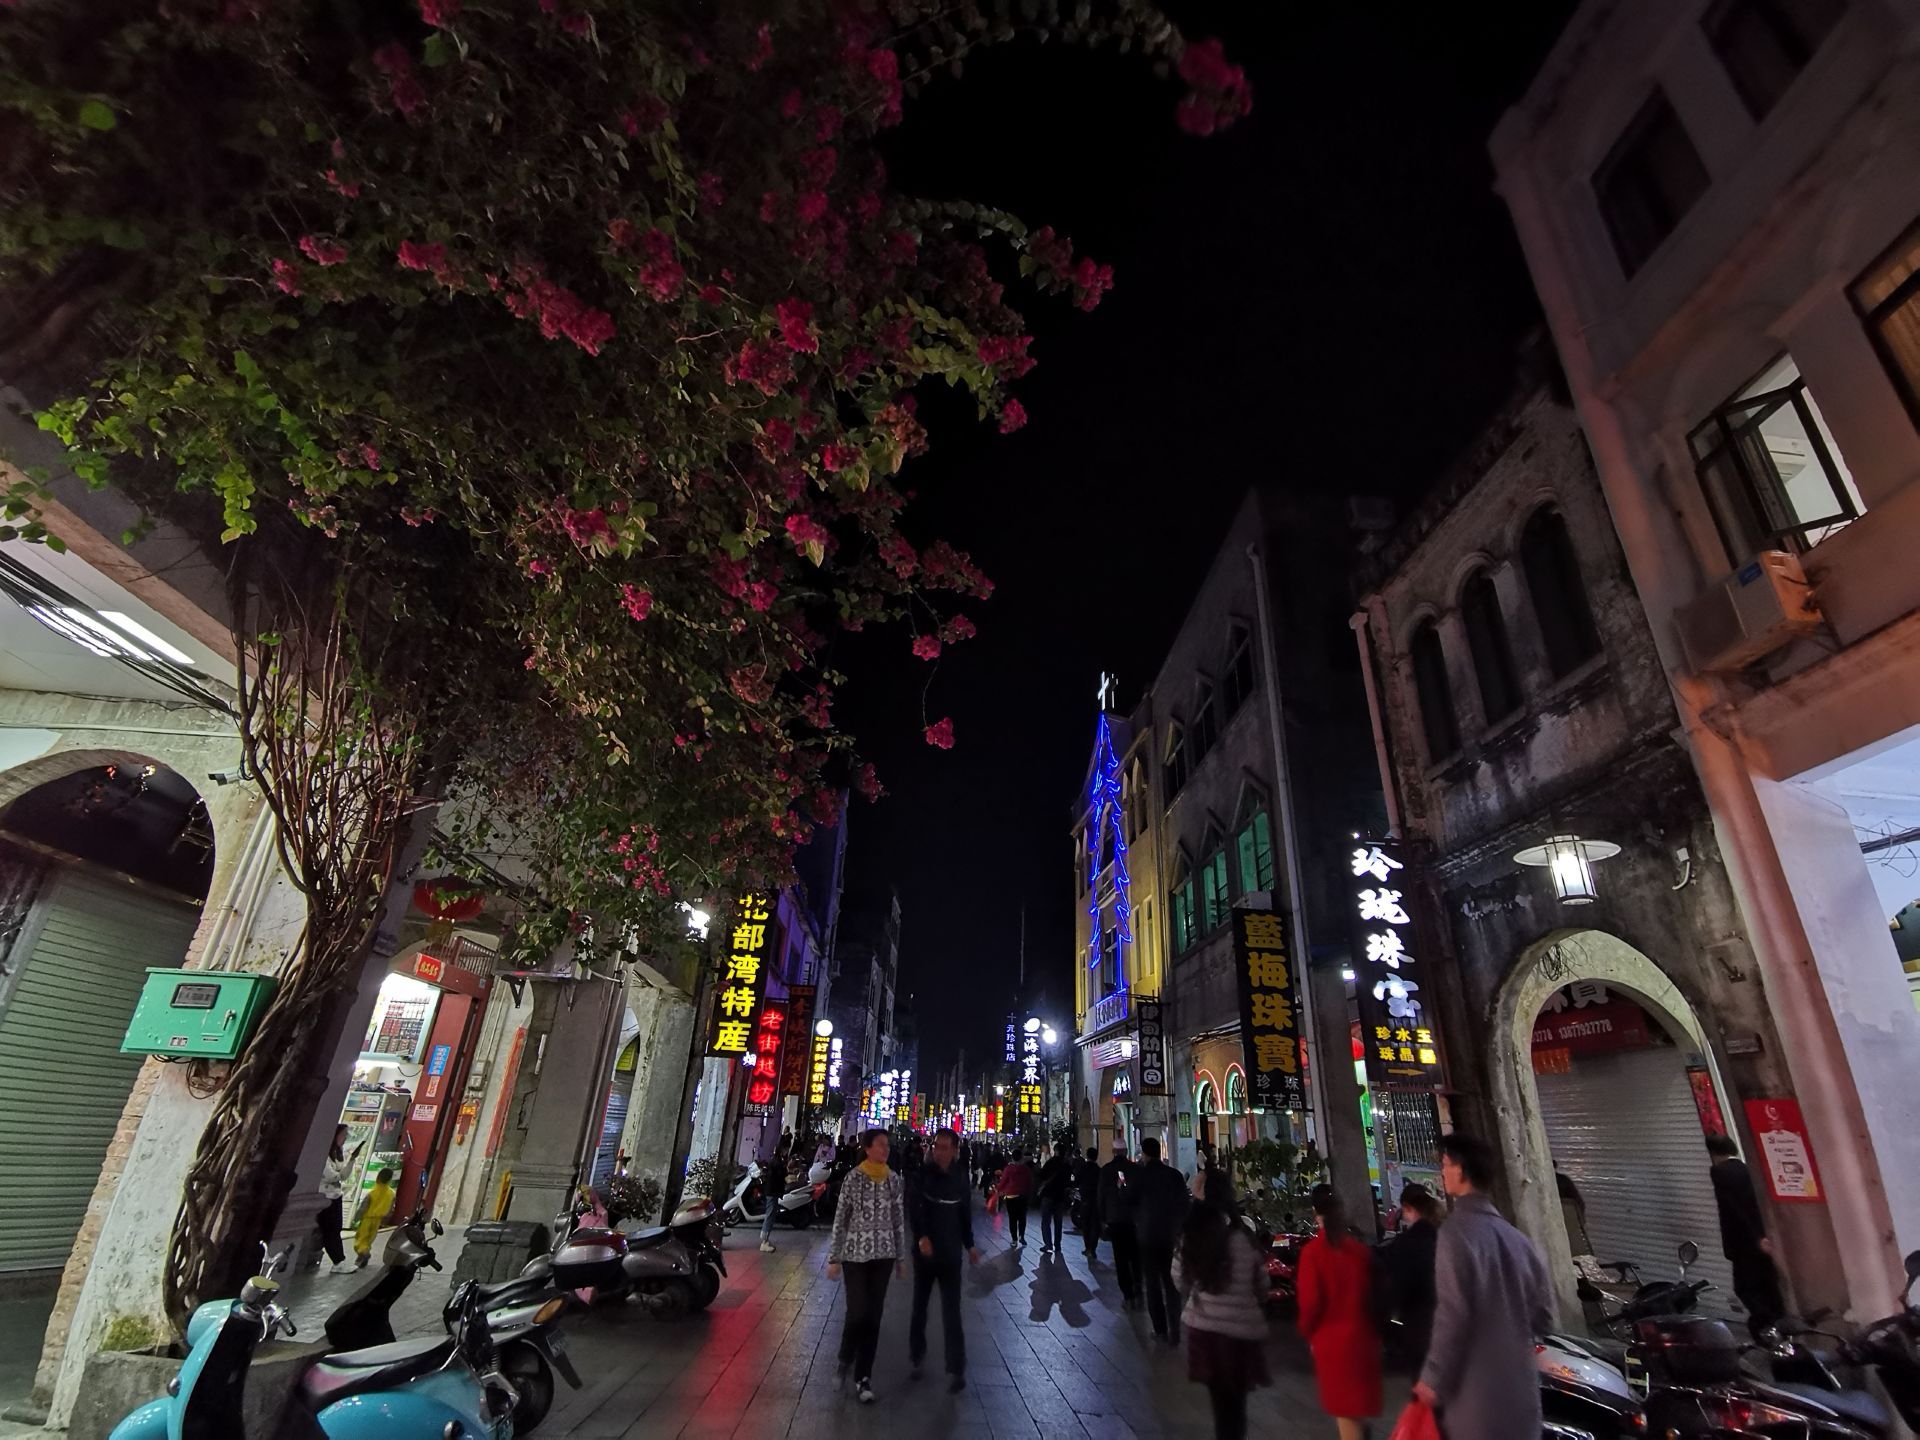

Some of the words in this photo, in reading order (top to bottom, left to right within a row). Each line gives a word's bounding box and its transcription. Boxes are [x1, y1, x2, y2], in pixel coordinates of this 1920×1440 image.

[1351, 847, 1422, 1018] 玲珑珠宝
[1258, 1093, 1303, 1110] 工艺品
